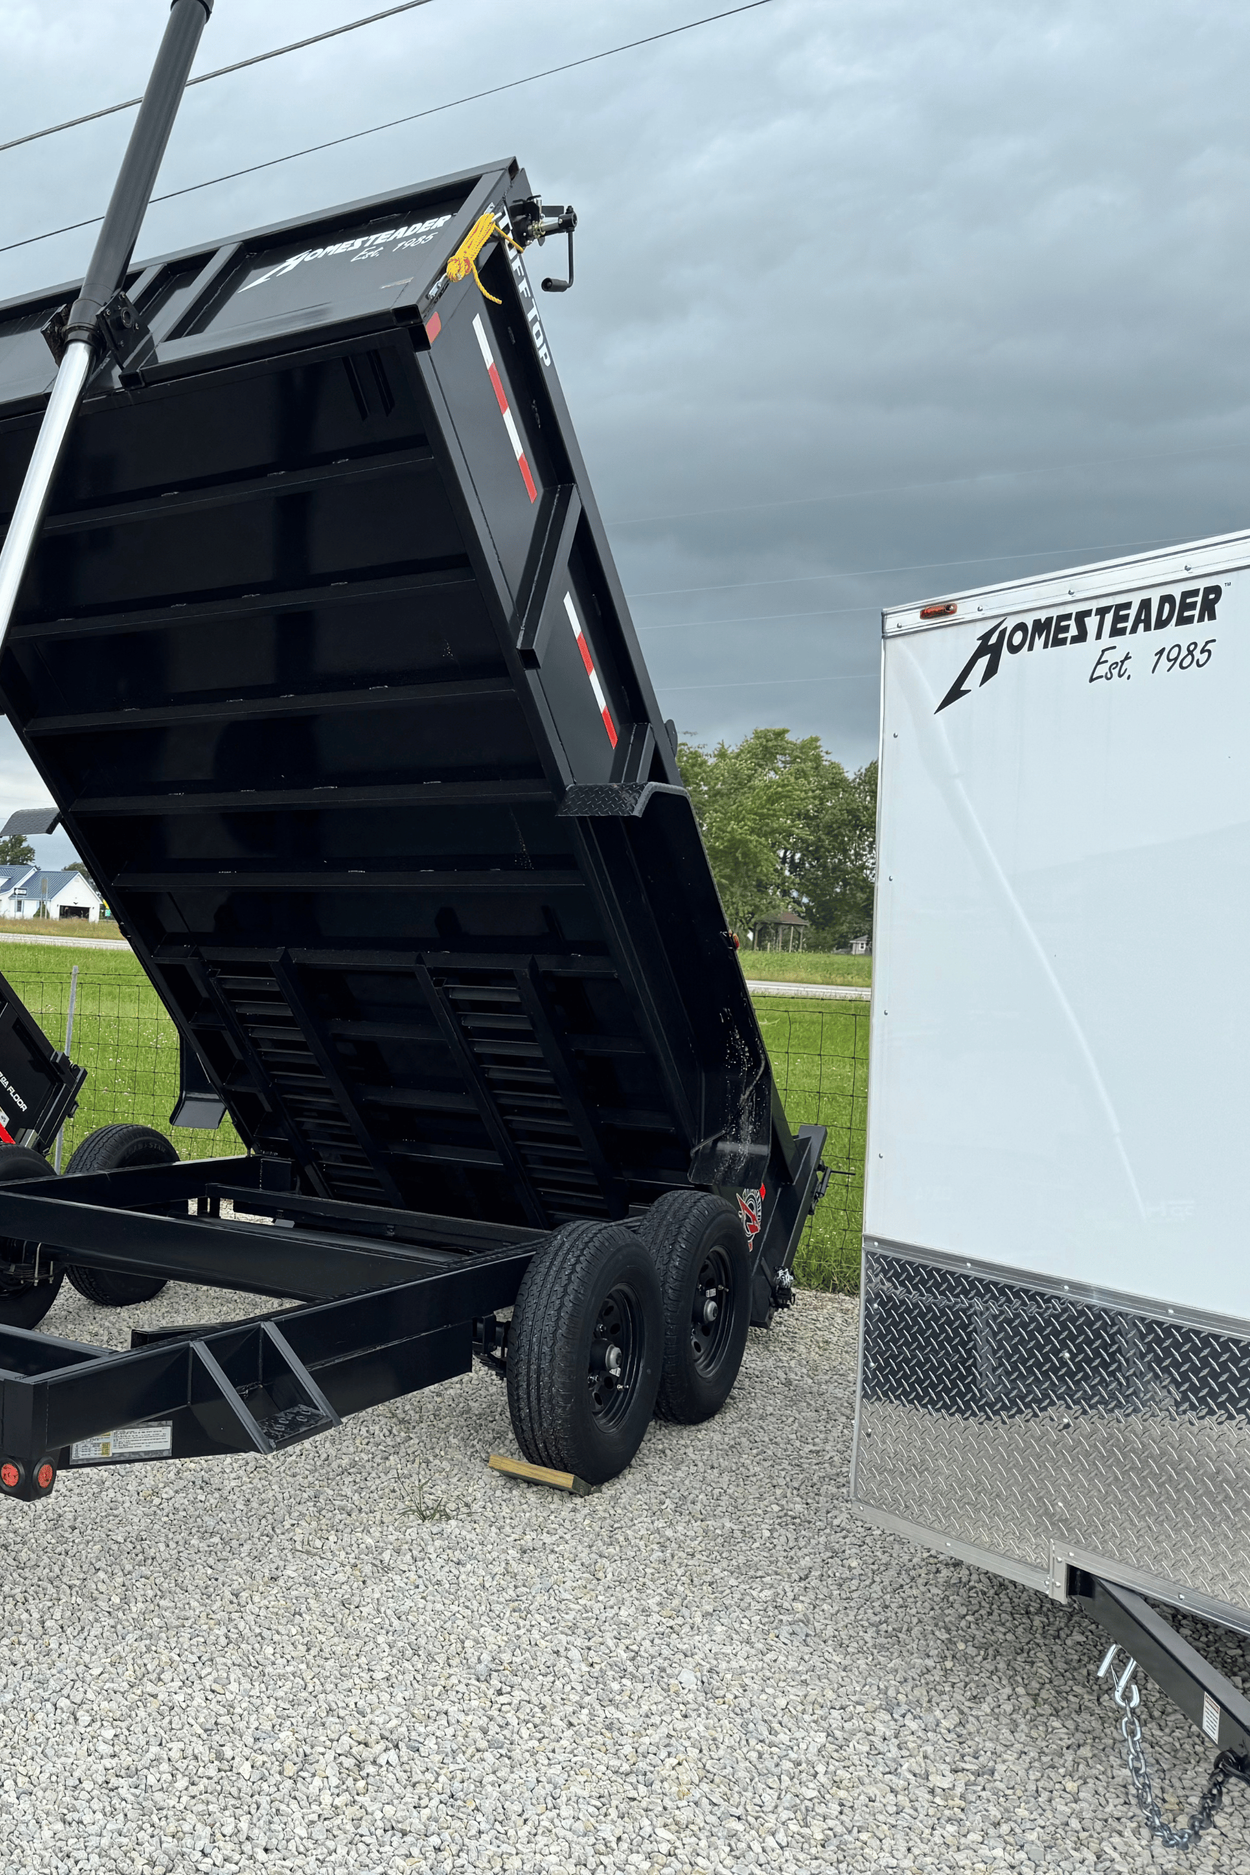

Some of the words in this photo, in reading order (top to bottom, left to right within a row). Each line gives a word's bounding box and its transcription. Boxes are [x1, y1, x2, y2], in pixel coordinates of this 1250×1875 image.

[237, 214, 452, 294] HOMESTEADER
[392, 231, 439, 252] 1985
[933, 584, 1223, 715] HOMESTEADER
[1088, 645, 1132, 684] Est.
[1150, 638, 1218, 675] 1985
[6, 1085, 28, 1112] FLOOR
